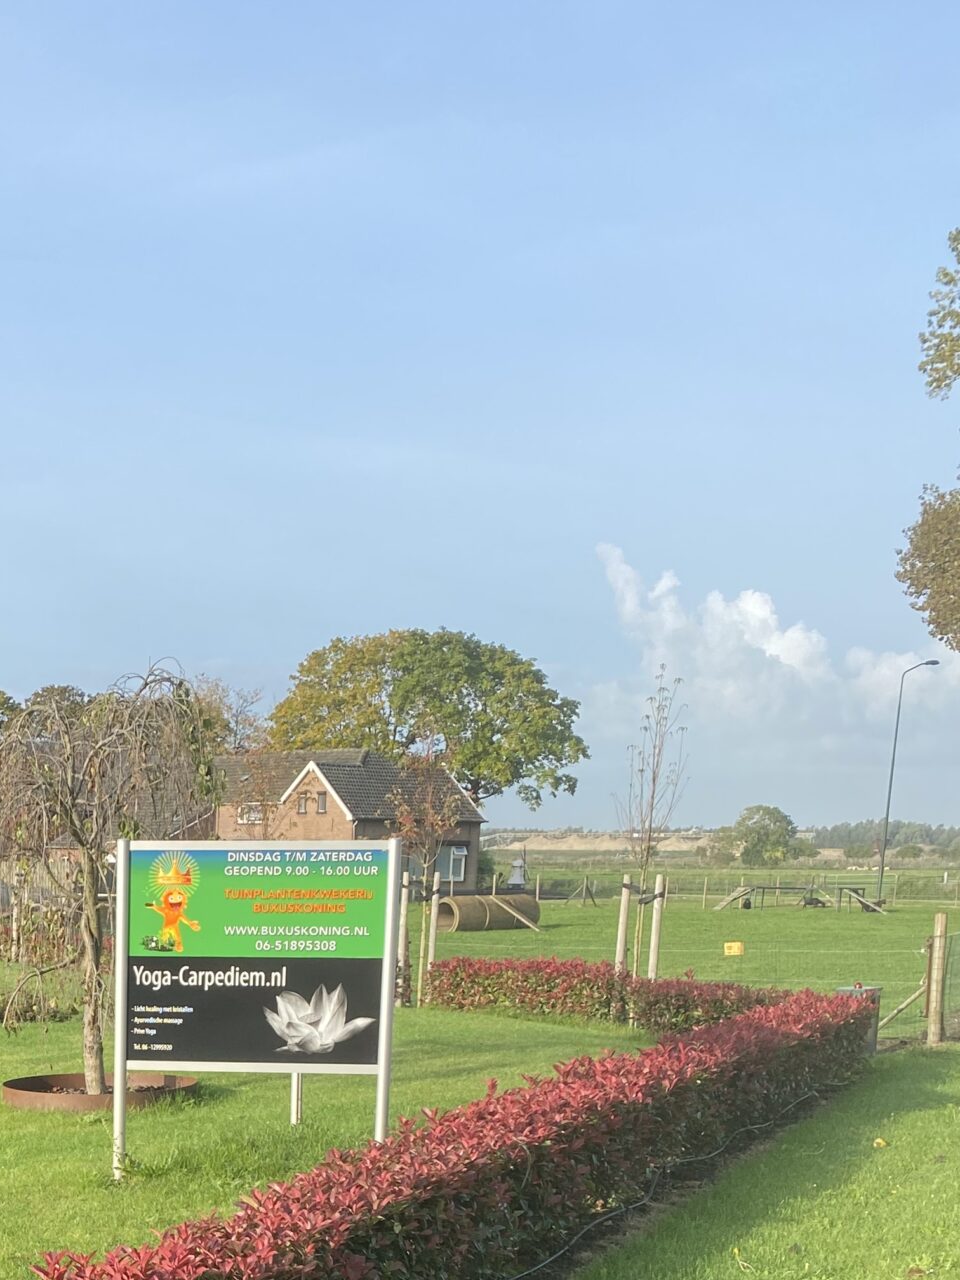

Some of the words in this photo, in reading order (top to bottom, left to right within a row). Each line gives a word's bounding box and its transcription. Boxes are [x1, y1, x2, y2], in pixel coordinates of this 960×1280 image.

[227, 851, 281, 862] DINSDAG
[284, 852, 307, 862] T/M
[310, 852, 373, 862] ZATERDAG
[224, 866, 282, 876] GEOPEND
[285, 866, 310, 876] 9.00
[320, 866, 350, 876] 16.00
[353, 866, 379, 876] UUR
[224, 889, 373, 899] TUINPLANTENKWEKERIJ
[253, 904, 346, 913] BUXUSKONING
[224, 926, 370, 936] WWW.BUXUSKONING.NL
[255, 940, 337, 951] 06-51895308
[133, 965, 287, 991] Yoga-Carpediem.nl
